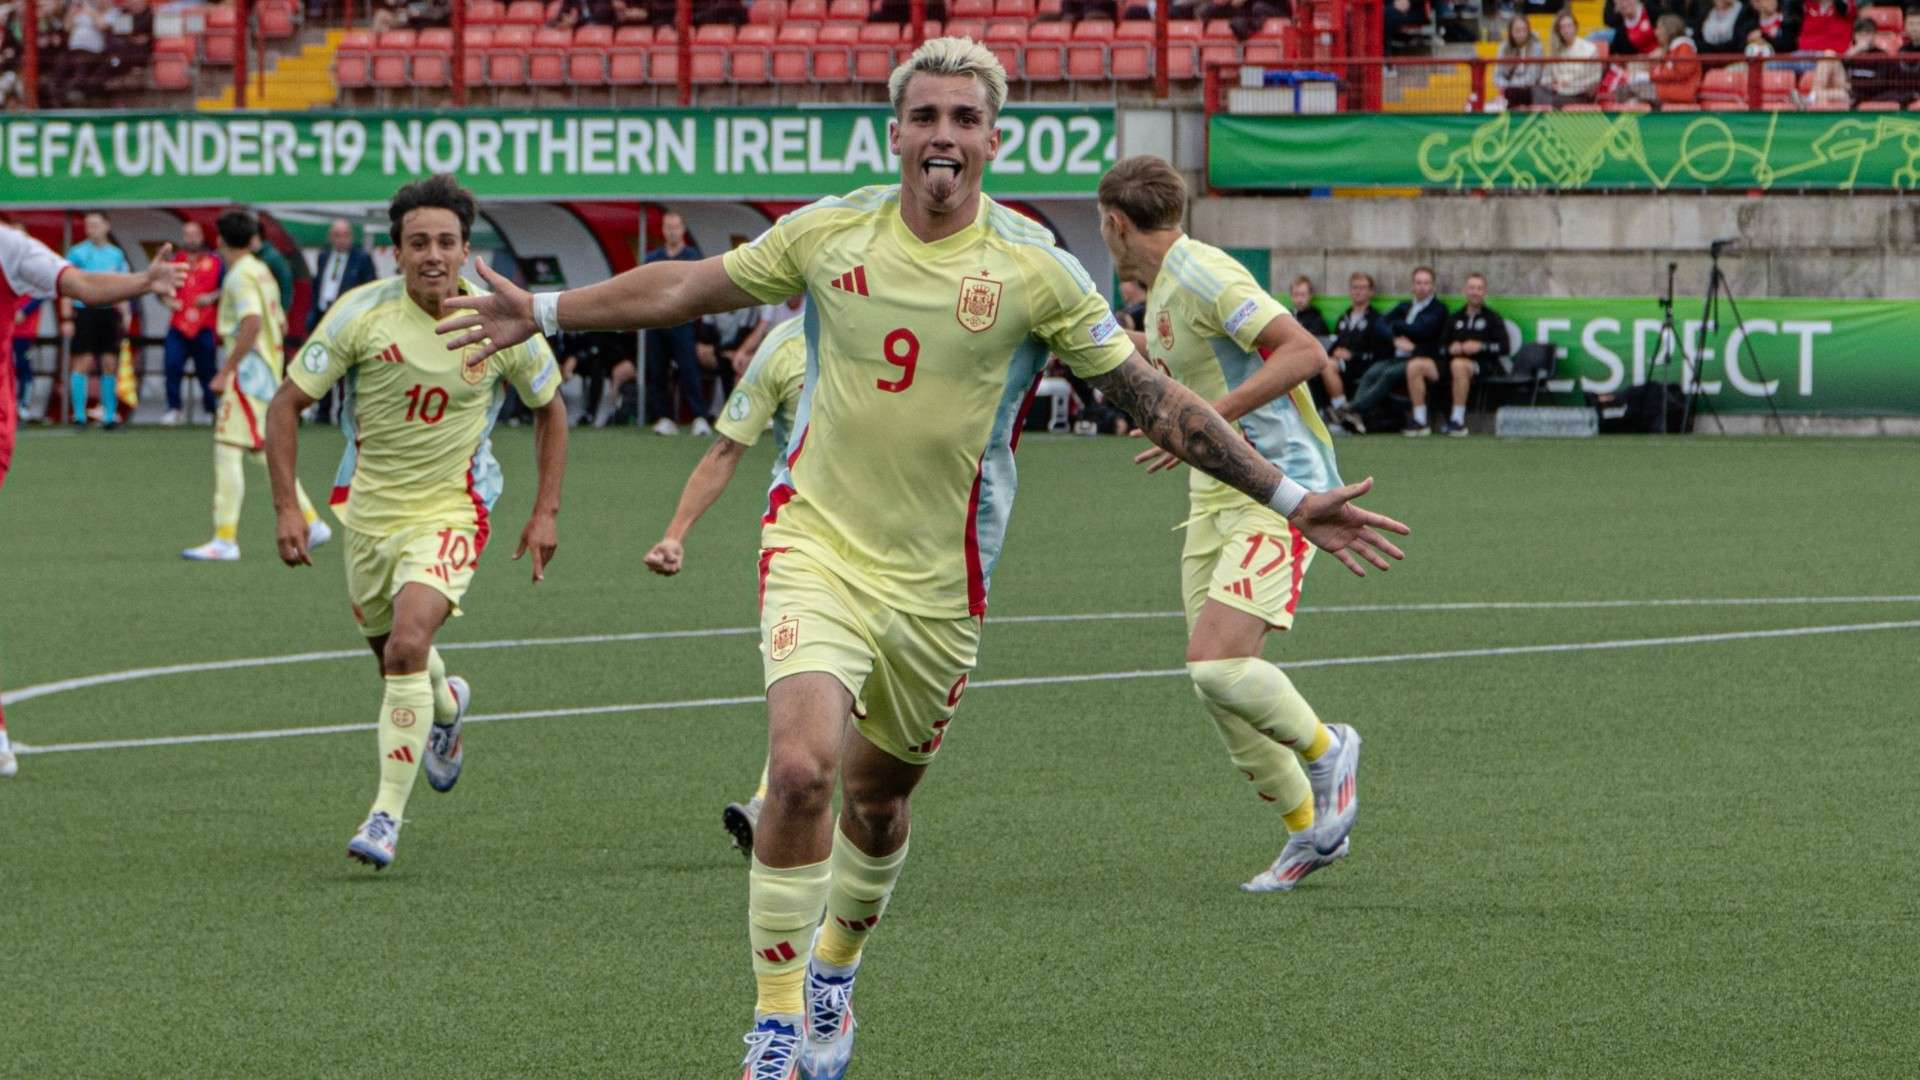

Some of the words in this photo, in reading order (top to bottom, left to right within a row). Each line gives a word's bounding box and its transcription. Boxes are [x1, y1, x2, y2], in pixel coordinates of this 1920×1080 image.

[0, 120, 106, 177] EFA
[111, 119, 367, 177] UNDER-19
[381, 117, 697, 175] NORTHERN
[713, 115, 900, 174] IRELA
[876, 327, 920, 393] 9
[404, 383, 449, 425] 10
[437, 527, 469, 571] 10
[1240, 531, 1286, 577] 17
